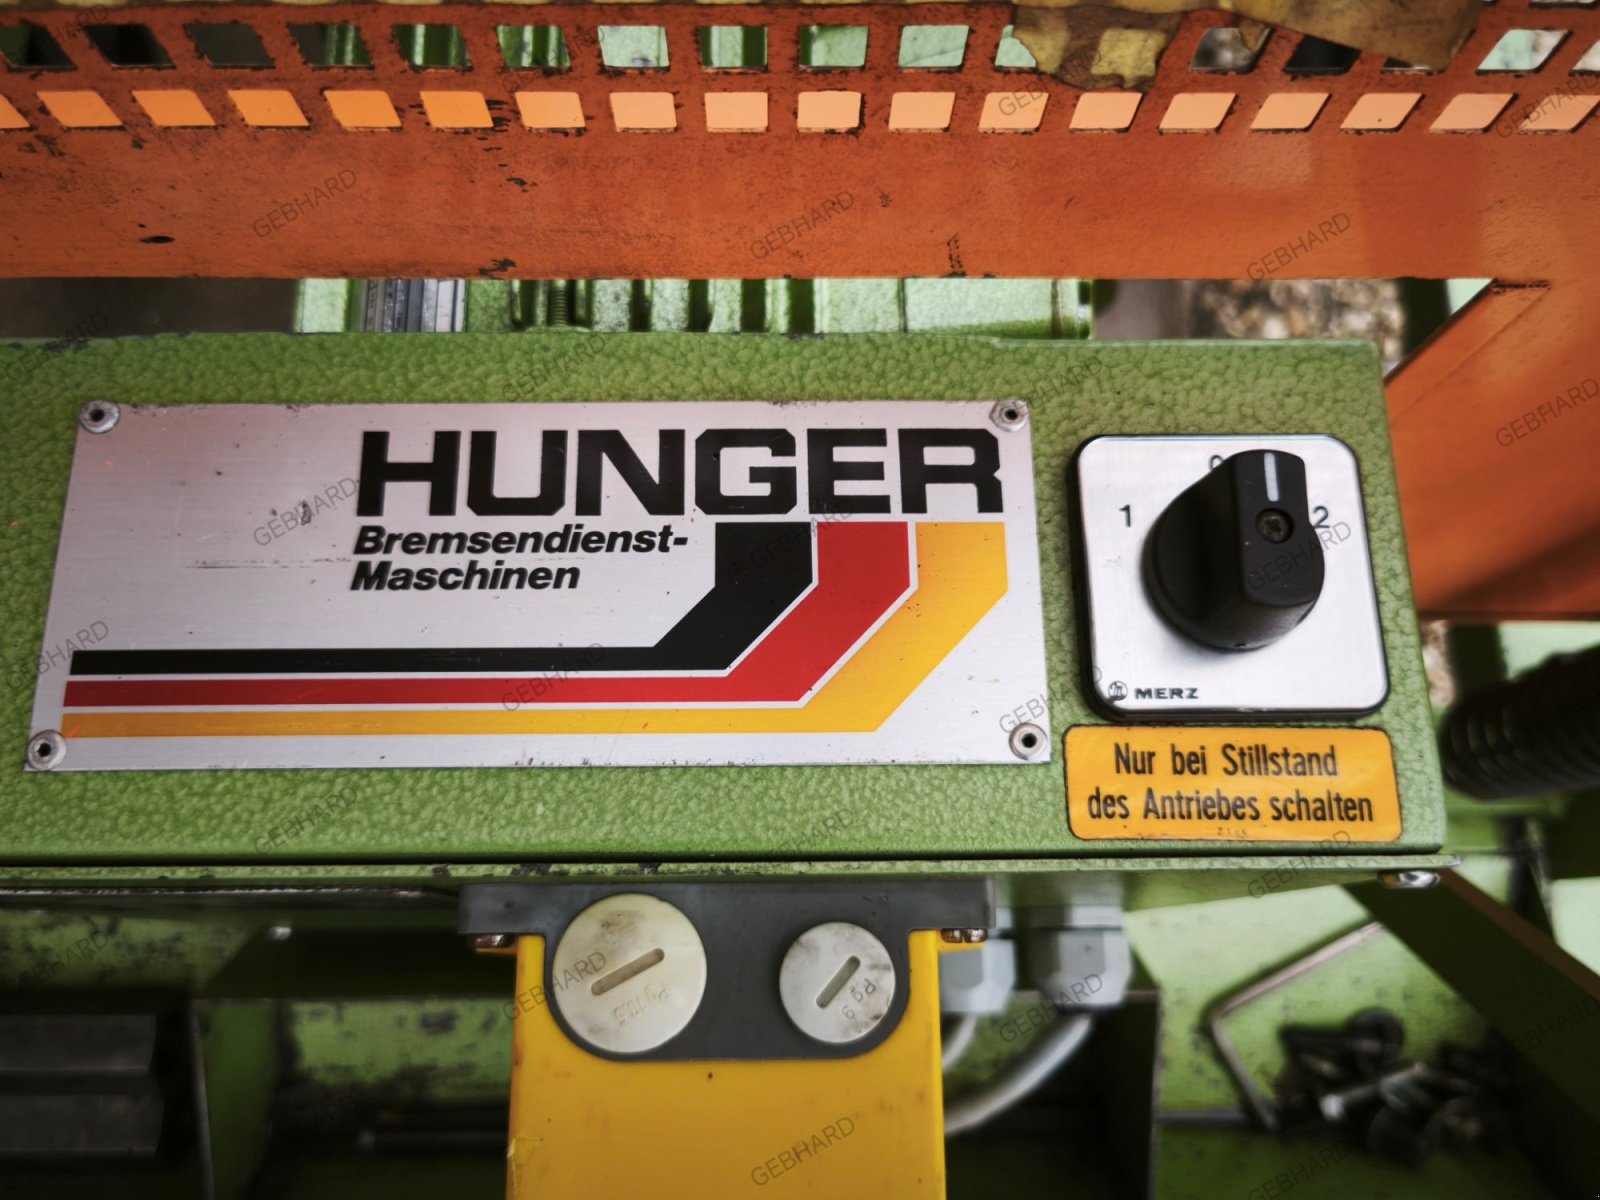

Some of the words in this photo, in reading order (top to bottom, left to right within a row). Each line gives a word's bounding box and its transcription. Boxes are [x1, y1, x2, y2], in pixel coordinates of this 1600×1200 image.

[357, 429, 1003, 516] HUNGER
[1119, 505, 1131, 527] 1
[1312, 506, 1330, 528] 2
[353, 524, 688, 555] Bremsendienst-
[350, 560, 580, 590] Maschinen
[1135, 687, 1198, 699] MERZ
[1114, 743, 1156, 775] Nur
[1171, 744, 1207, 775] bei
[1221, 743, 1338, 776] Stillstand
[1088, 786, 1129, 819] des
[1143, 788, 1260, 821] Antriebes
[1270, 790, 1374, 822] schalten
